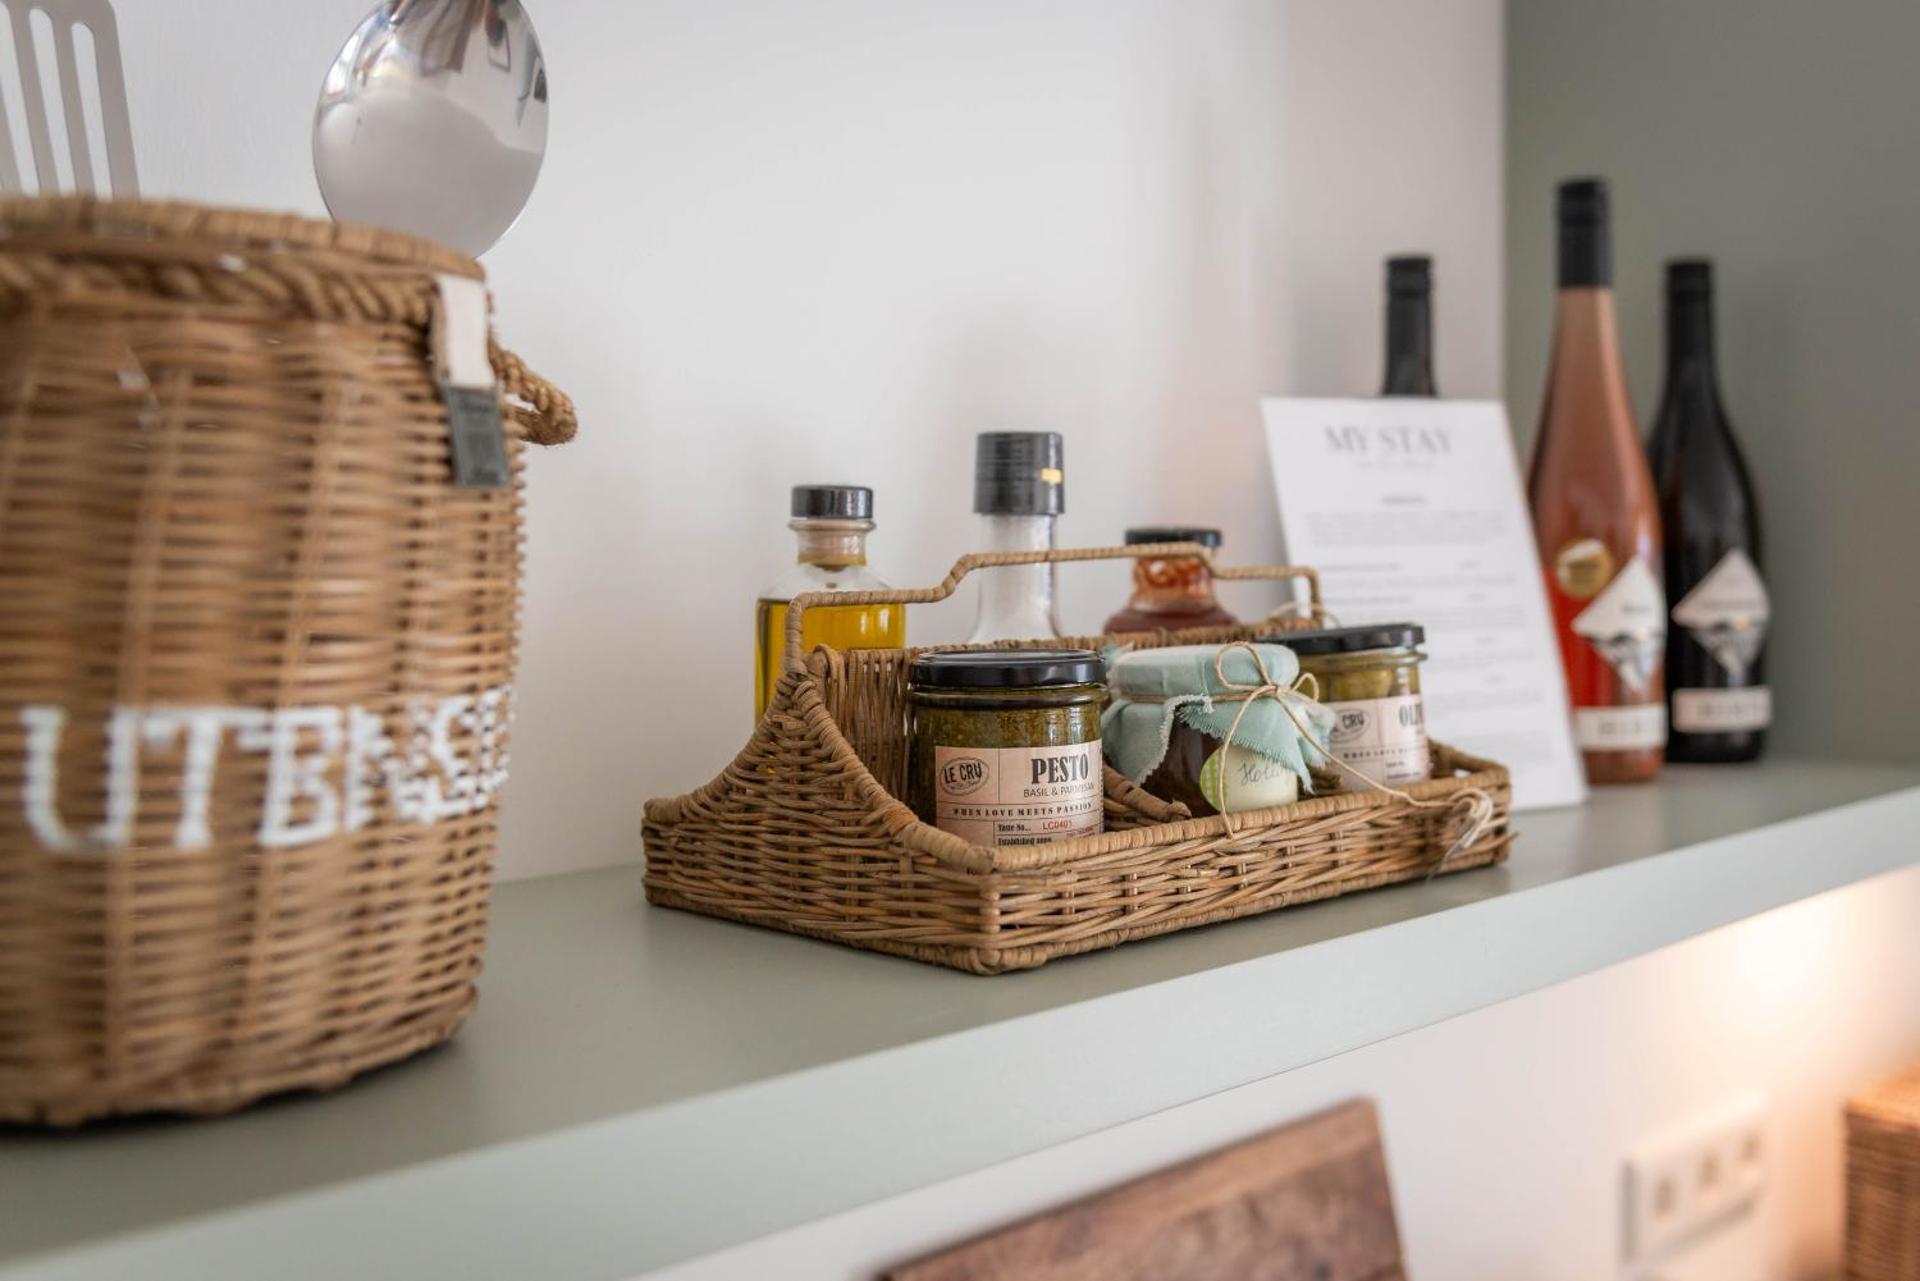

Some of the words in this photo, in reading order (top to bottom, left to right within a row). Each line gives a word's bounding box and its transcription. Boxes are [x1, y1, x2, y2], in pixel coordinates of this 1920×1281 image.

[1325, 425, 1369, 452] MY
[1377, 425, 1452, 454] STAY
[944, 767, 957, 784] LE
[959, 762, 983, 781] CRU
[1031, 753, 1089, 784] PESTO
[1023, 787, 1050, 798] BASIL
[1051, 786, 1058, 796] &
[985, 808, 1013, 817] LOVE
[1018, 805, 1053, 816] MEETS
